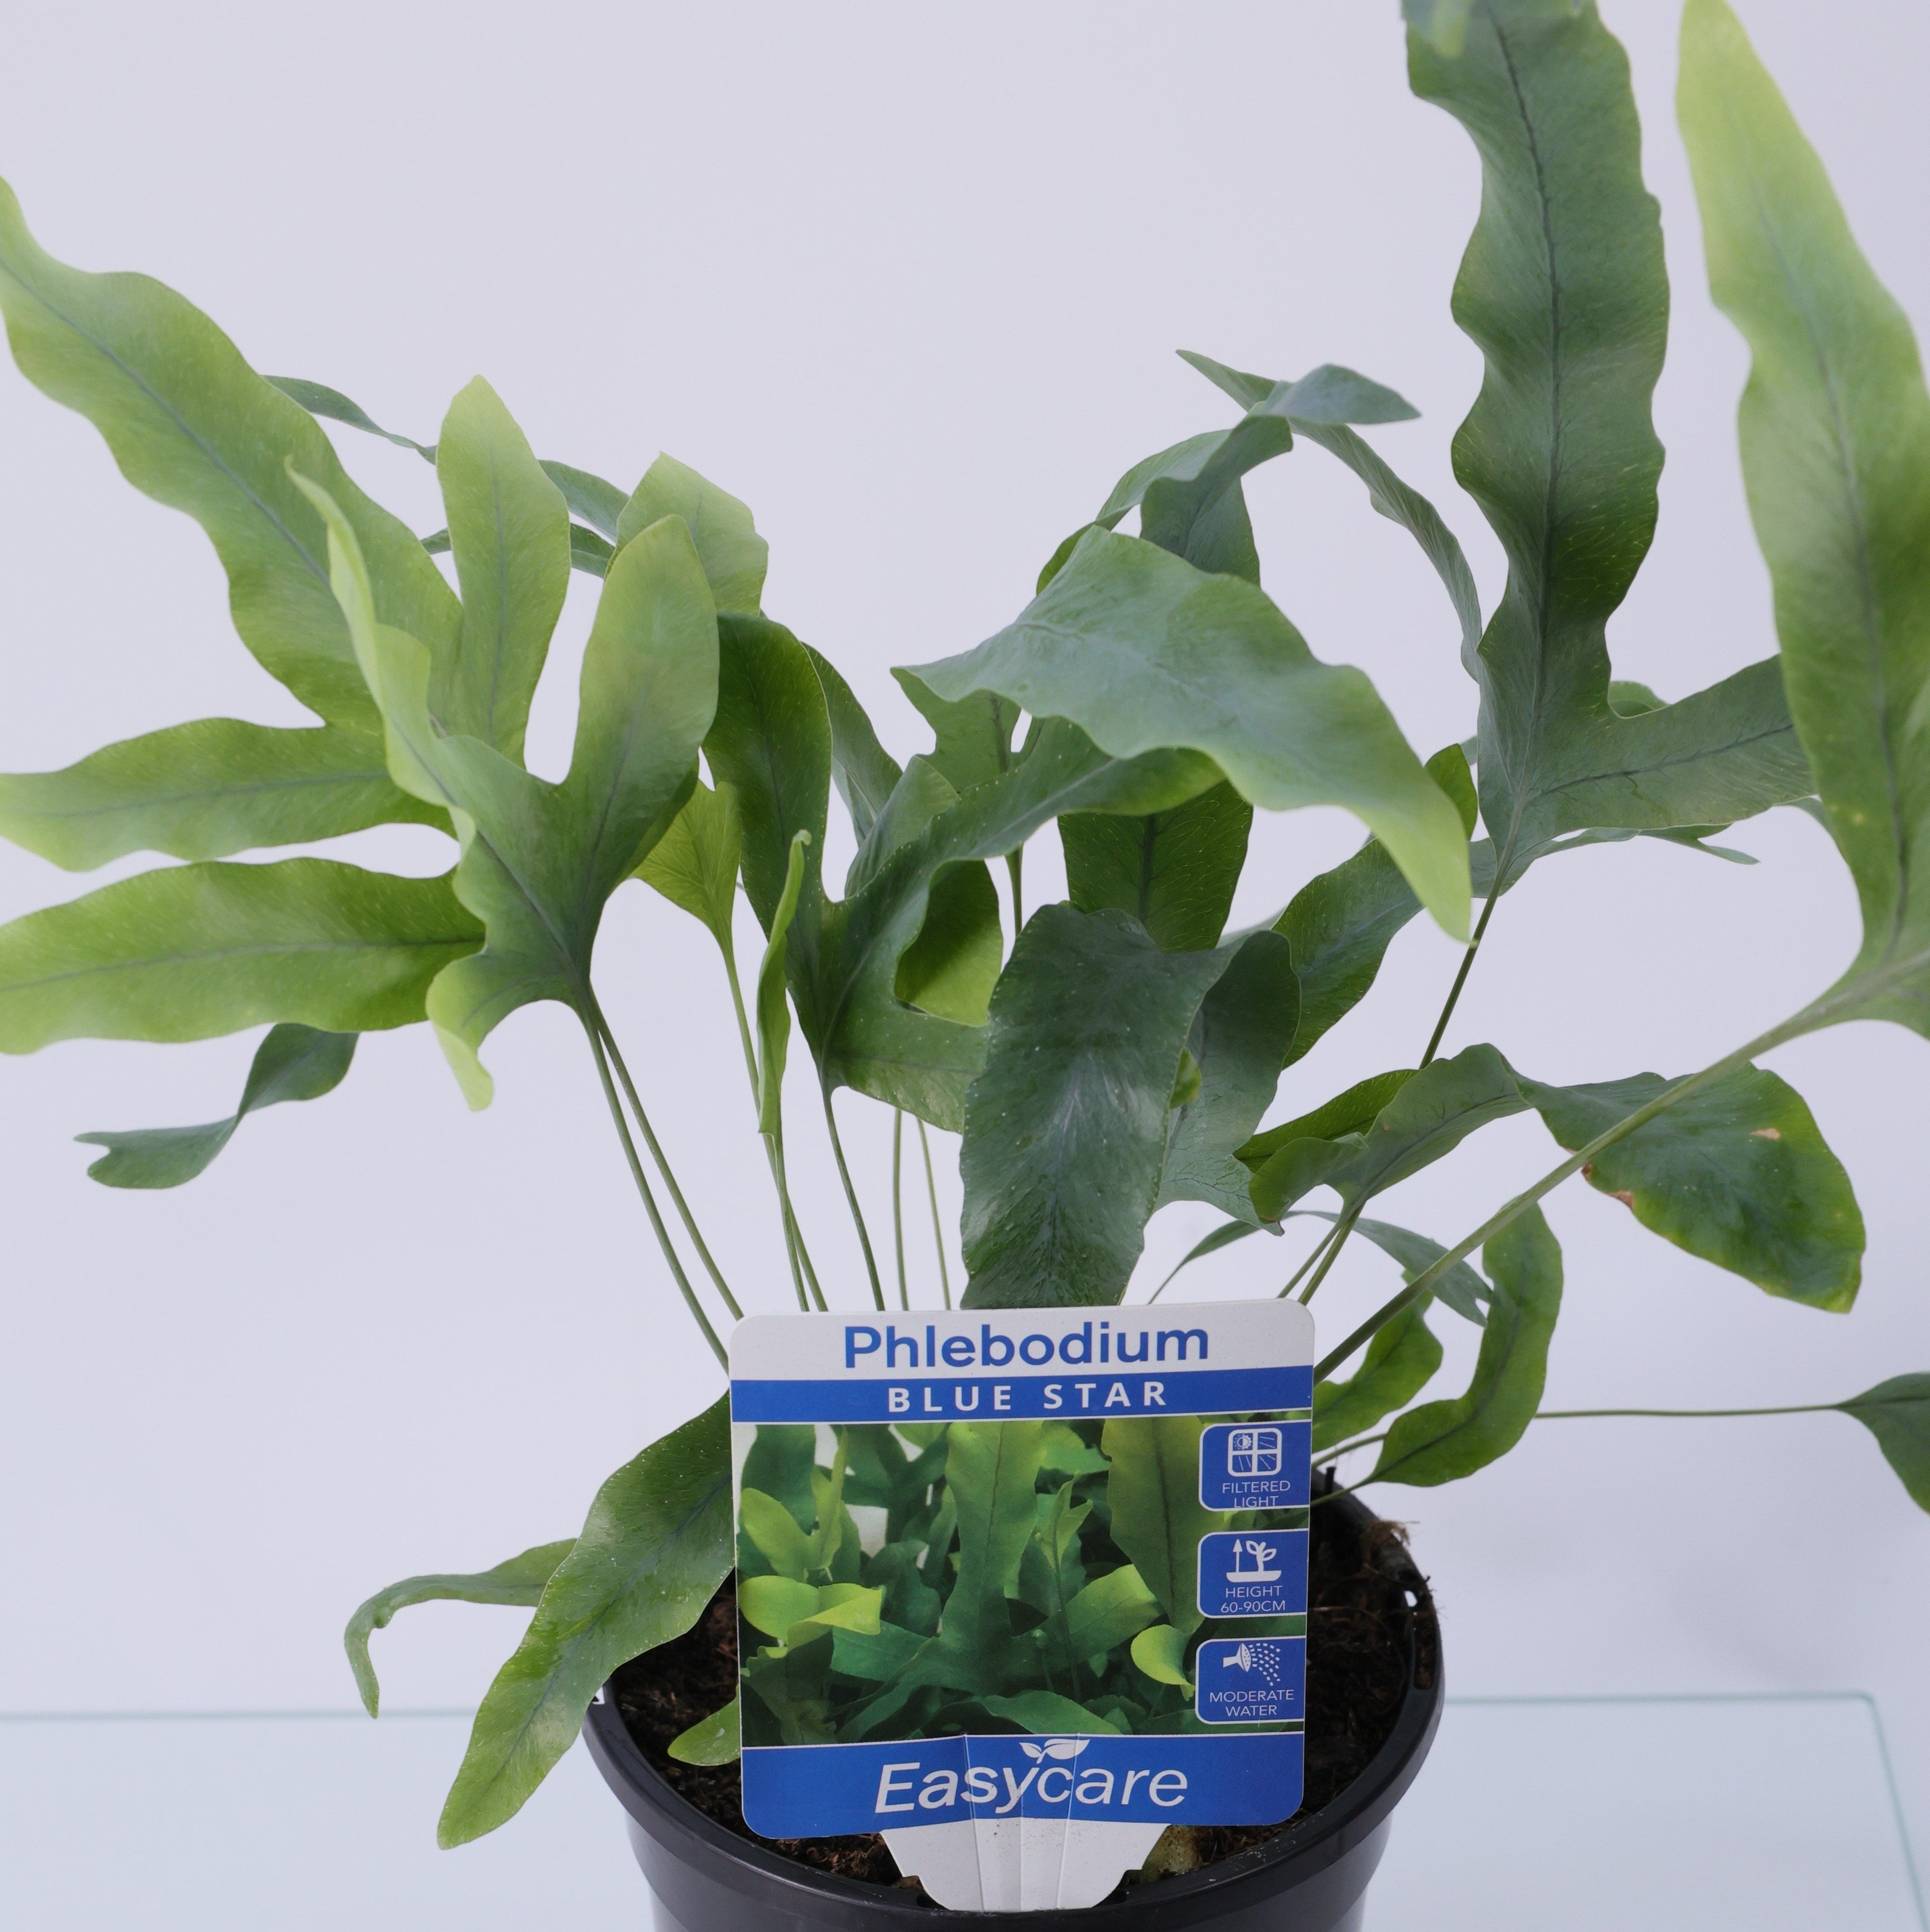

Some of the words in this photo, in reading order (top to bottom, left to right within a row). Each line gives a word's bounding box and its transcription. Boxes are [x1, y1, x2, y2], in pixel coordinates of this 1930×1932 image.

[844, 1322, 1208, 1368] Phlebodium
[888, 1386, 1012, 1413] BLUE
[1043, 1381, 1167, 1408] STAR
[1222, 1481, 1290, 1493] FILTERED
[1234, 1495, 1279, 1508] LIGHT
[1225, 1585, 1283, 1598] HEIGHT
[1220, 1600, 1286, 1613] 60-90CM
[1209, 1689, 1294, 1703] MODERATE
[1225, 1705, 1277, 1717] WATER
[875, 1762, 1188, 1813] Easycare
